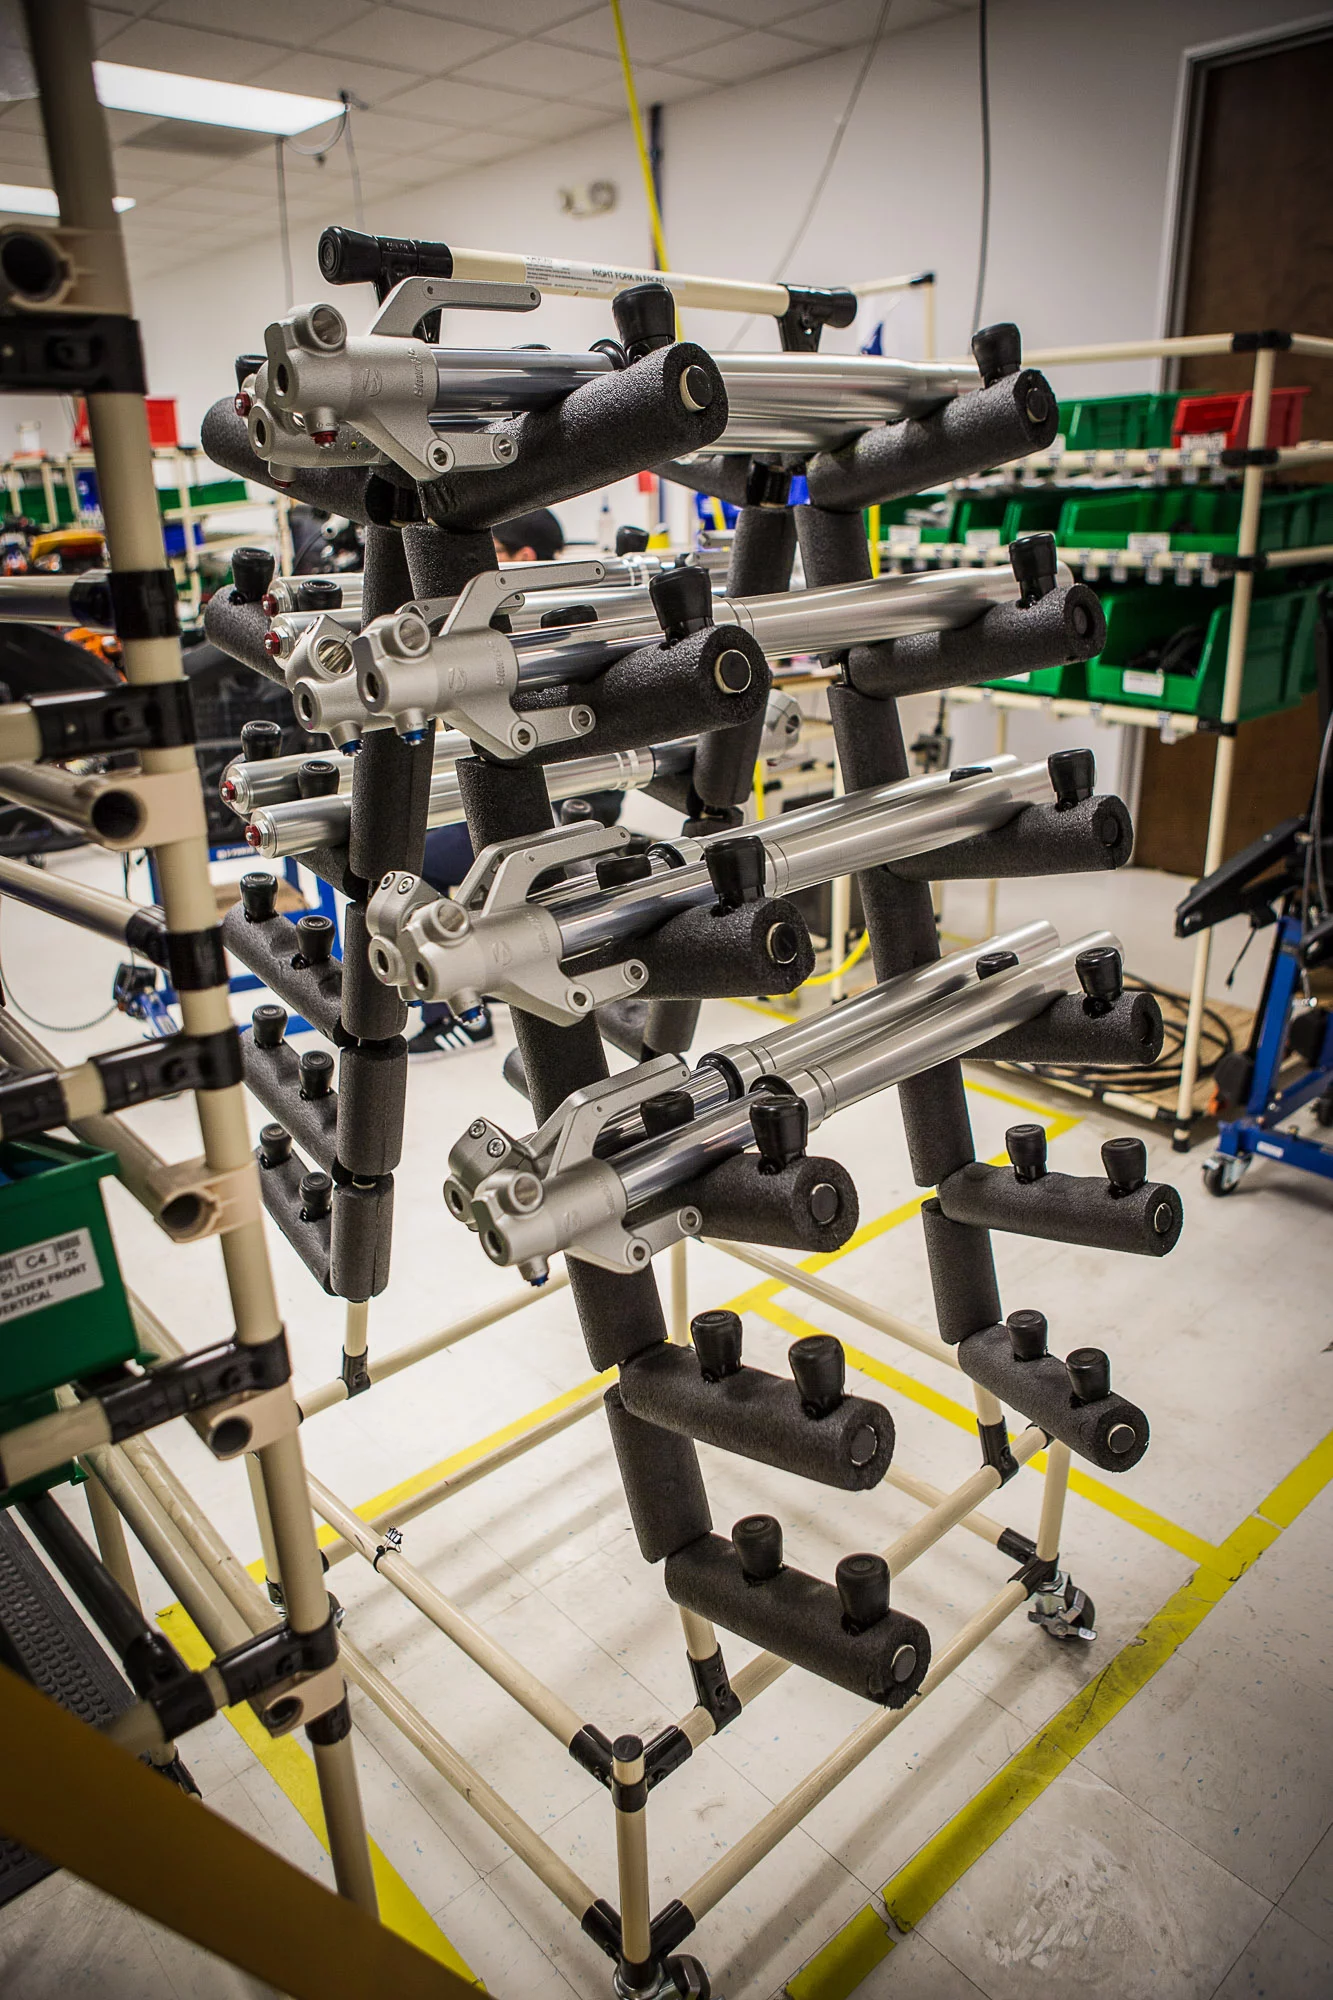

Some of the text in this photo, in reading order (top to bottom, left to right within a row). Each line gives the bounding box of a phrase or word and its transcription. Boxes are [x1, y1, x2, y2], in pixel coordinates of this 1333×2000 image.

[592, 268, 614, 279] RIGHT
[26, 1252, 47, 1268] C4
[1, 1263, 87, 1301] SLIDER FRONT
